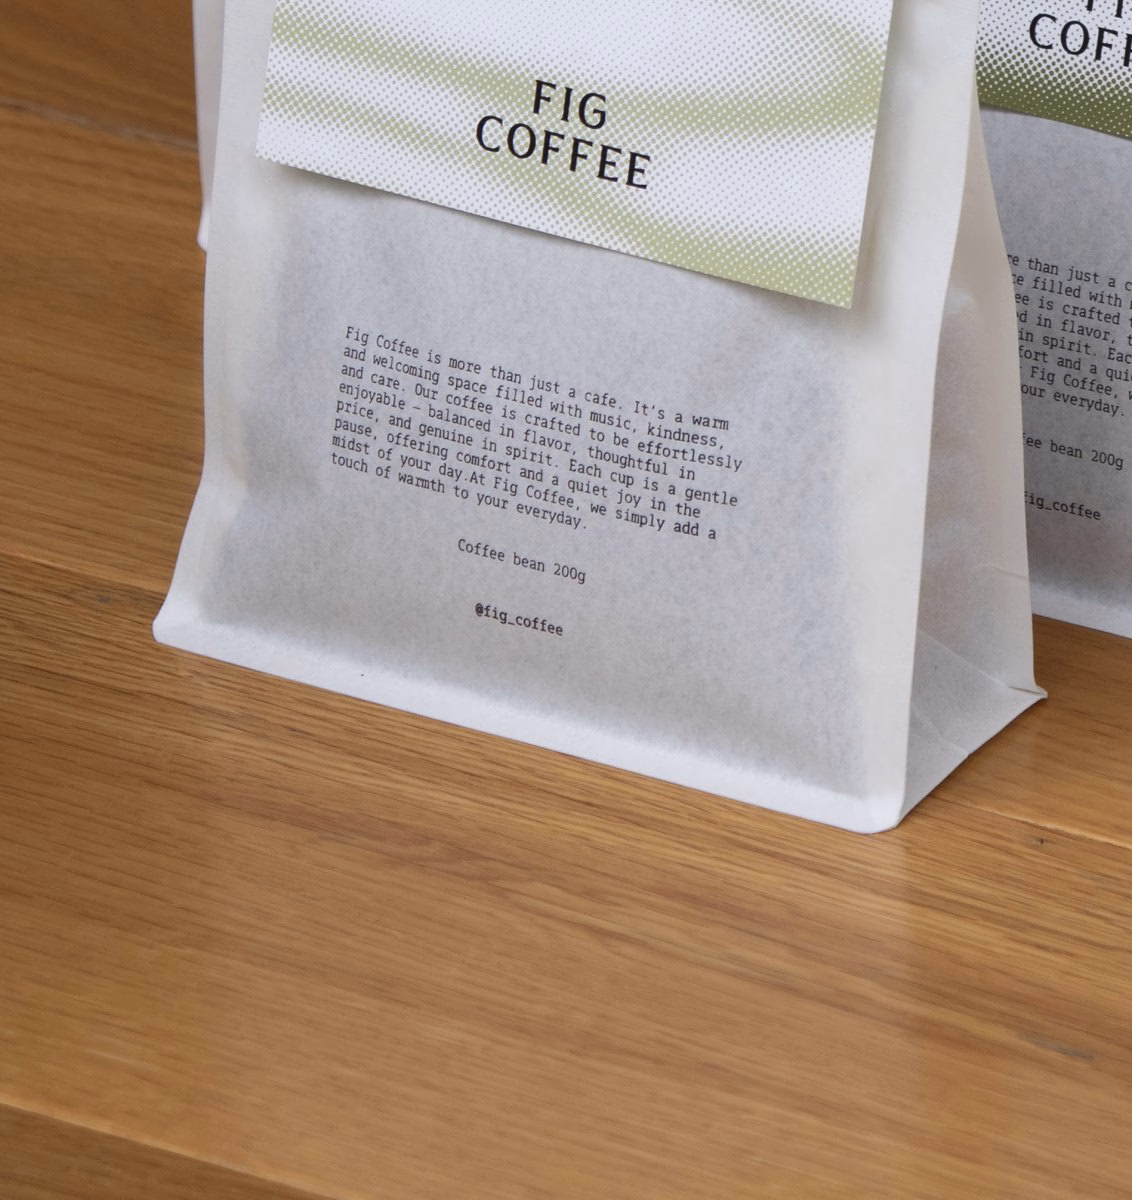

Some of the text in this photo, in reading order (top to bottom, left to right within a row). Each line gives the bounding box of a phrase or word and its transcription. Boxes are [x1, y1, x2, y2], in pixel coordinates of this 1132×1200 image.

[533, 79, 606, 130] FIG
[476, 115, 651, 189] COFFEE
[1027, 258, 1058, 275] than
[1067, 266, 1100, 284] just
[1032, 276, 1081, 298] filled
[1061, 319, 1114, 344] flavor,
[1063, 304, 1120, 325] crafted
[1042, 336, 1096, 356] spirit.
[344, 347, 723, 450] and welcoming space filled with music, kindness,
[346, 326, 729, 430] Fig Coffee is more than just a cafe. It's a warm
[1064, 374, 1117, 398] Coffee,
[341, 364, 742, 472] and care. Our coffee is crafted to be effortlessly
[1054, 392, 1124, 417] everyday.
[336, 400, 738, 506] price, and genuine in spirit. Each cup is a gentle
[339, 383, 405, 410] enjoyable
[428, 404, 491, 432] balanced
[499, 423, 514, 438] in
[524, 429, 576, 456] flavor,
[588, 446, 668, 475] thoughtful
[679, 466, 695, 480] in
[1050, 440, 1082, 458] bean
[1091, 450, 1124, 470] 200g
[331, 452, 586, 530] touch of warmth to your everyday.
[332, 436, 716, 540] midst of your day.At Fig Coffee, we simply add a
[334, 418, 700, 518] pause, offering comfort and a quiet joy in the
[458, 538, 586, 584] Coffee bean 200g
[475, 603, 563, 636] @fig_coffee
